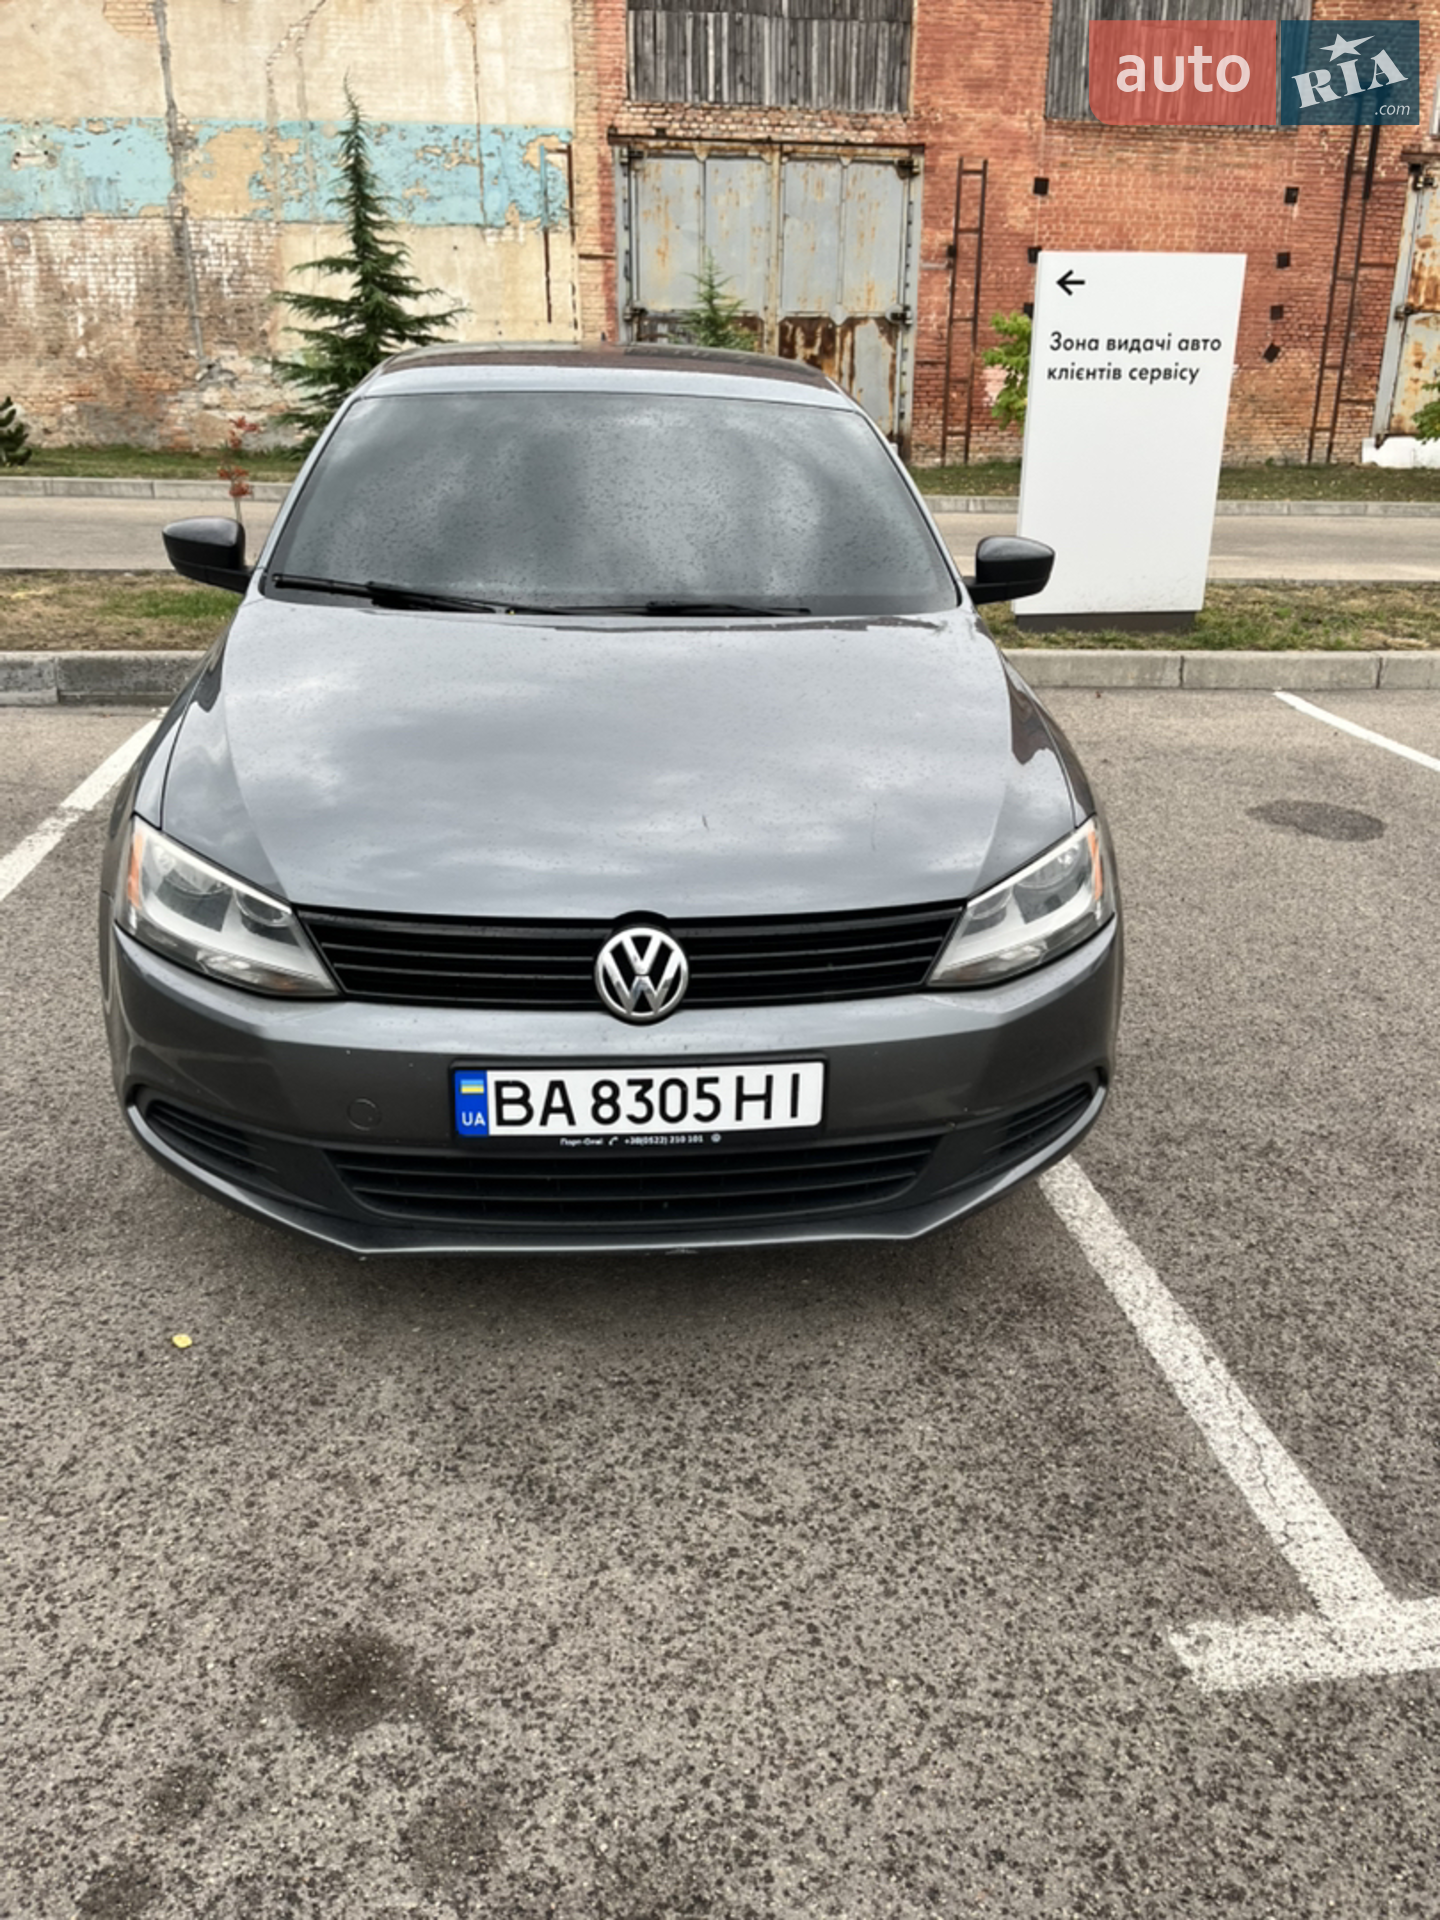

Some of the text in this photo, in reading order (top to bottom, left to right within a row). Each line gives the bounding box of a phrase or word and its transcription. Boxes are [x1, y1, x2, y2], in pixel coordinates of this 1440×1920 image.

[1049, 330, 1222, 354] Зона видачі авто
[1047, 362, 1200, 385] клієнтів сервісу
[493, 1073, 801, 1126] BA 8305 HI
[461, 1111, 486, 1126] UA
